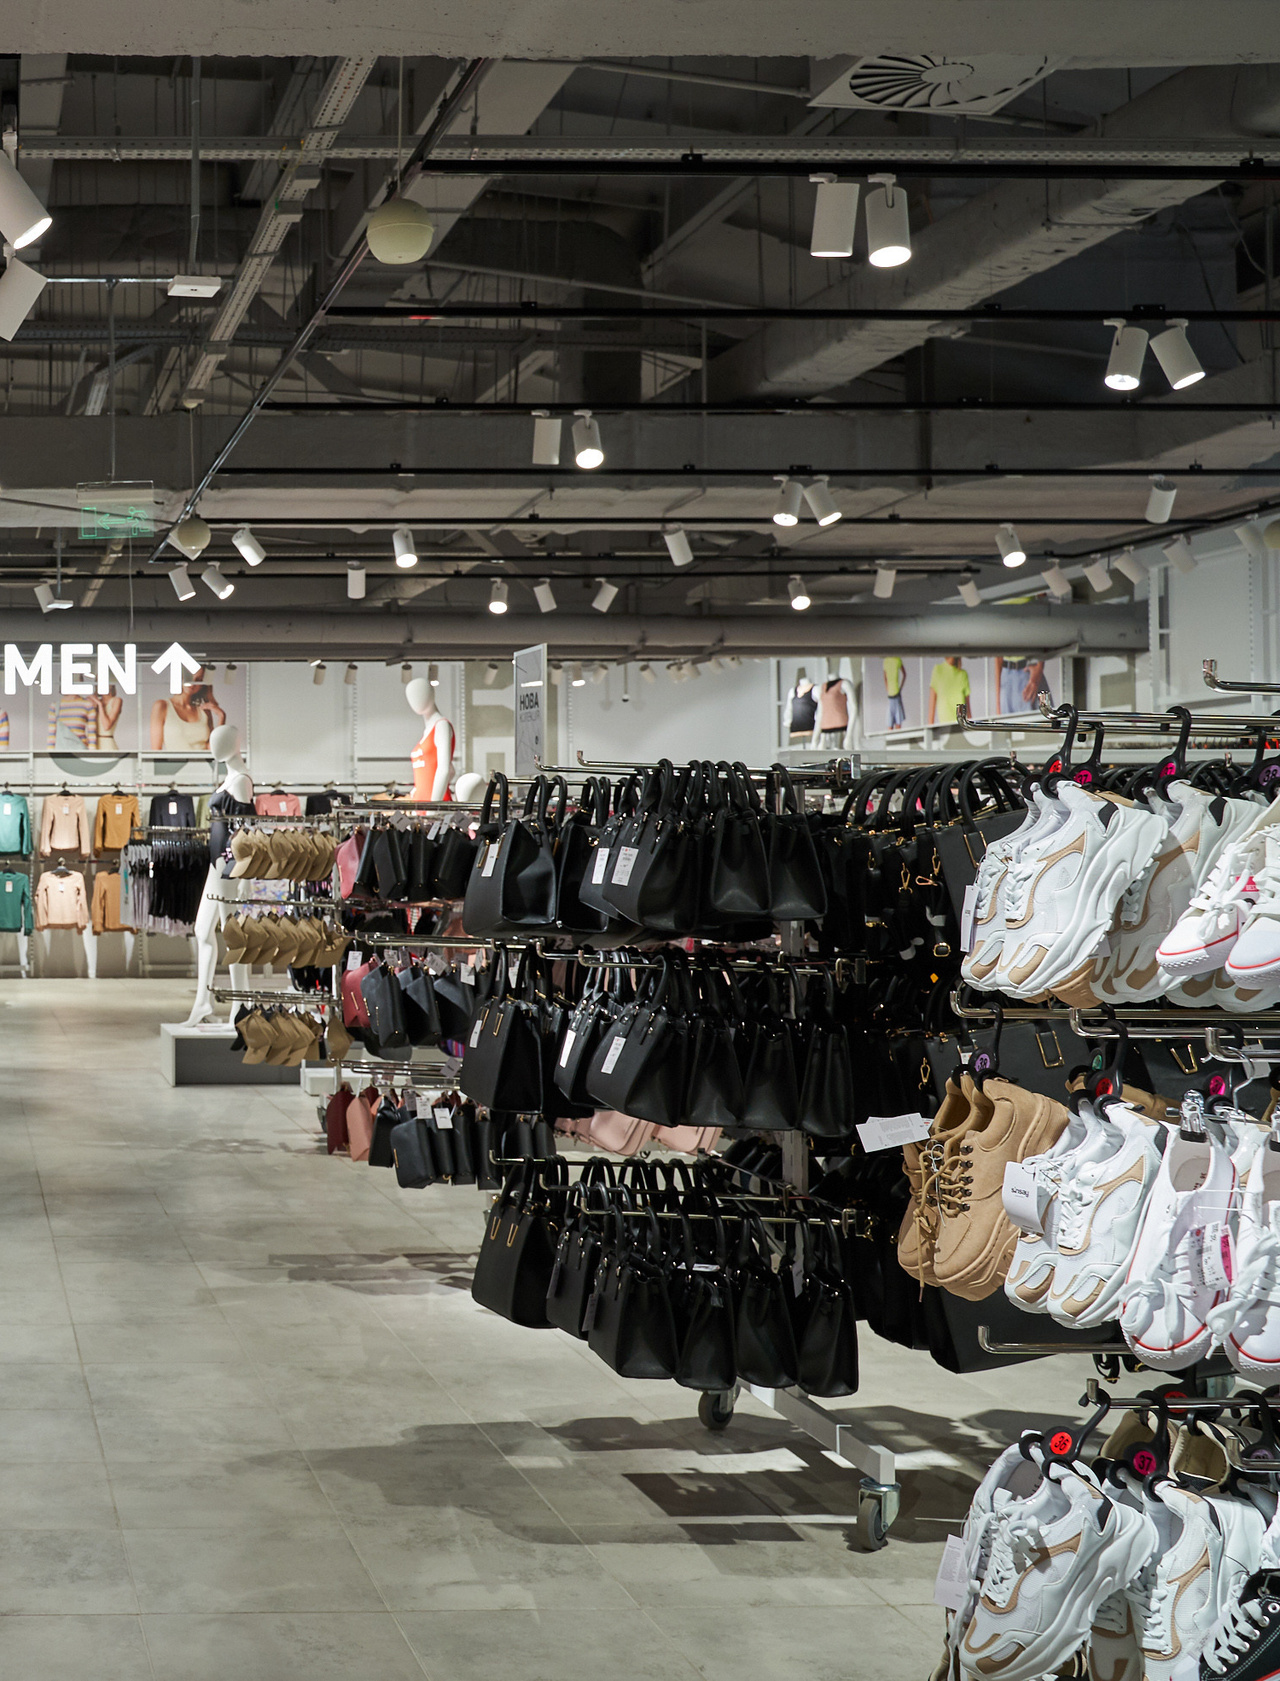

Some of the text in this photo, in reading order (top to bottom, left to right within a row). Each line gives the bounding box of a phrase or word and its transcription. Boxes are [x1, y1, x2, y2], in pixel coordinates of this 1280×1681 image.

[520, 692, 540, 711] НОВА
[1054, 1435, 1070, 1451] 36
[1138, 1454, 1153, 1472] 37
